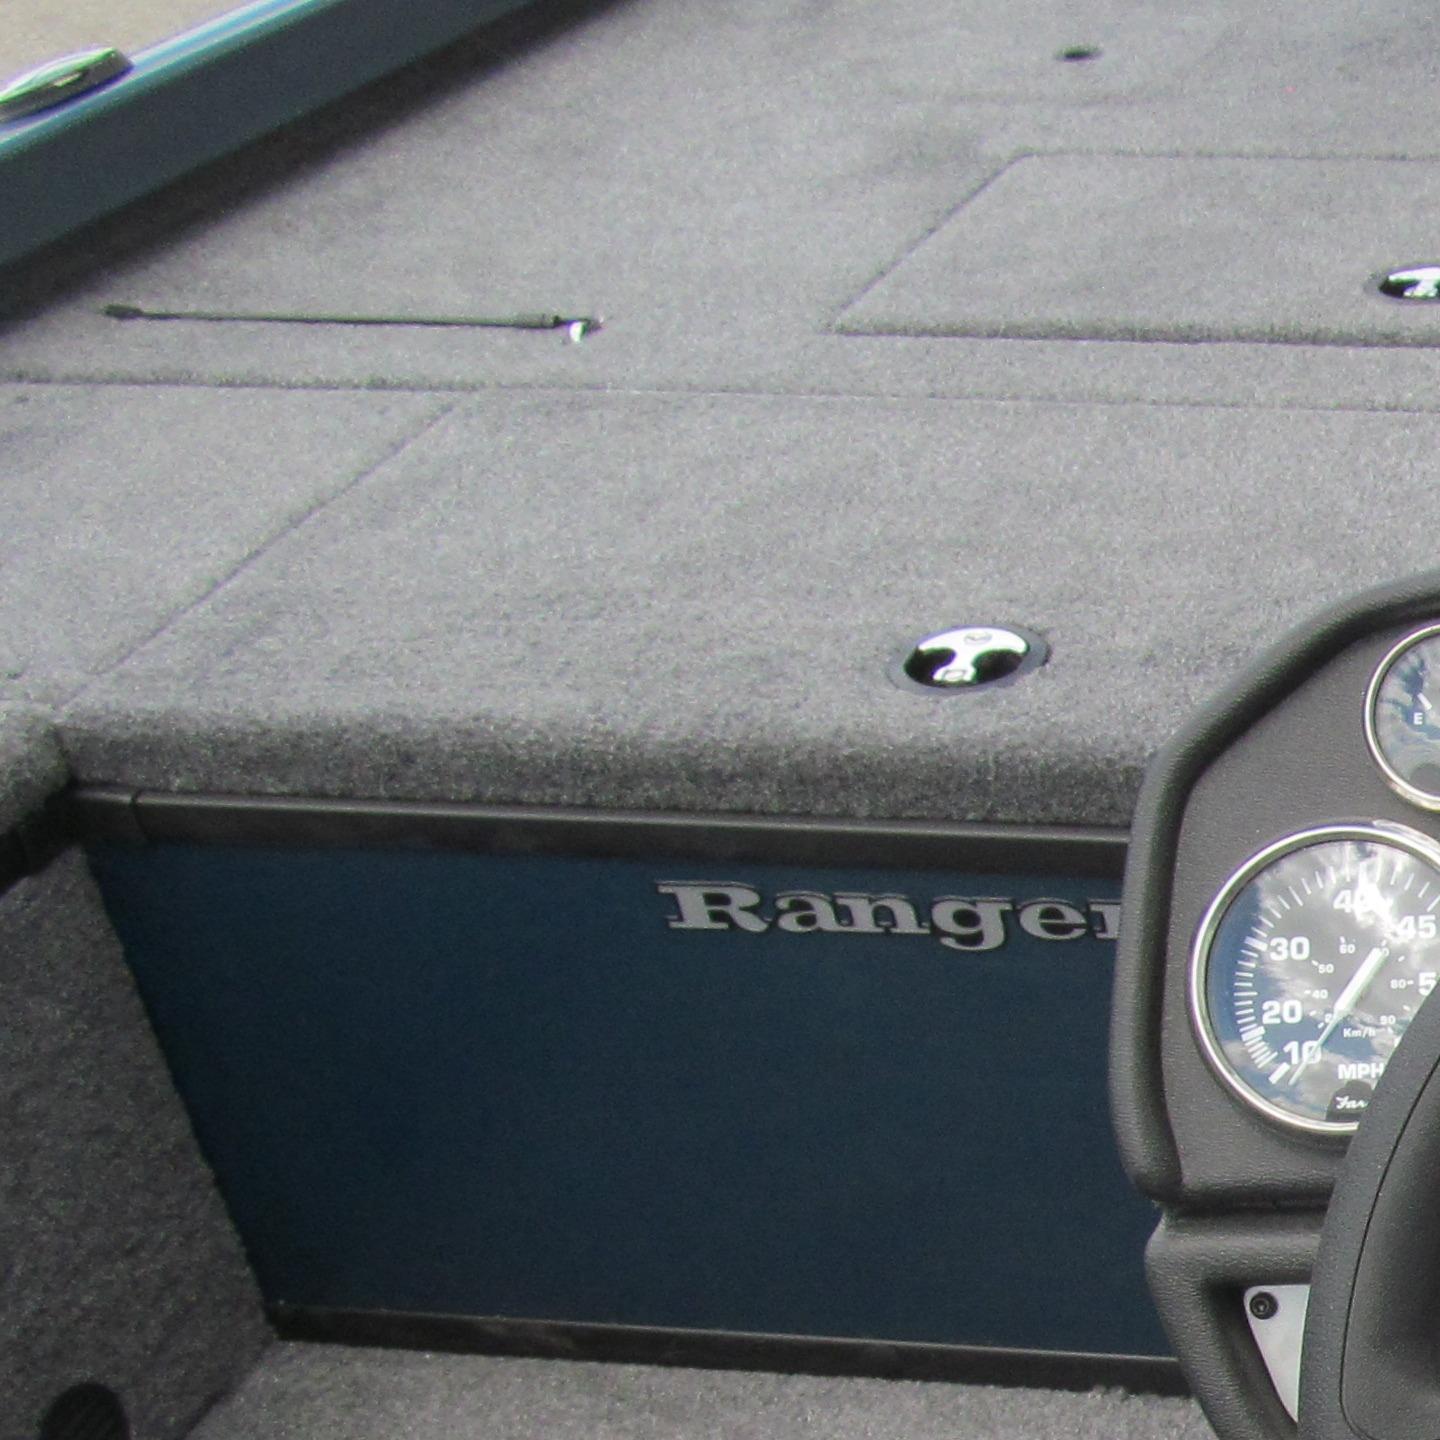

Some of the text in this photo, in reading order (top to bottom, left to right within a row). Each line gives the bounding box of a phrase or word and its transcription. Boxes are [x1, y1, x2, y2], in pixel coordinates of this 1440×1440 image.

[1414, 713, 1423, 725] E
[1269, 936, 1310, 961] 30
[1261, 1000, 1302, 1025] 20
[1283, 1040, 1322, 1065] 10
[1337, 1063, 1384, 1080] MPH
